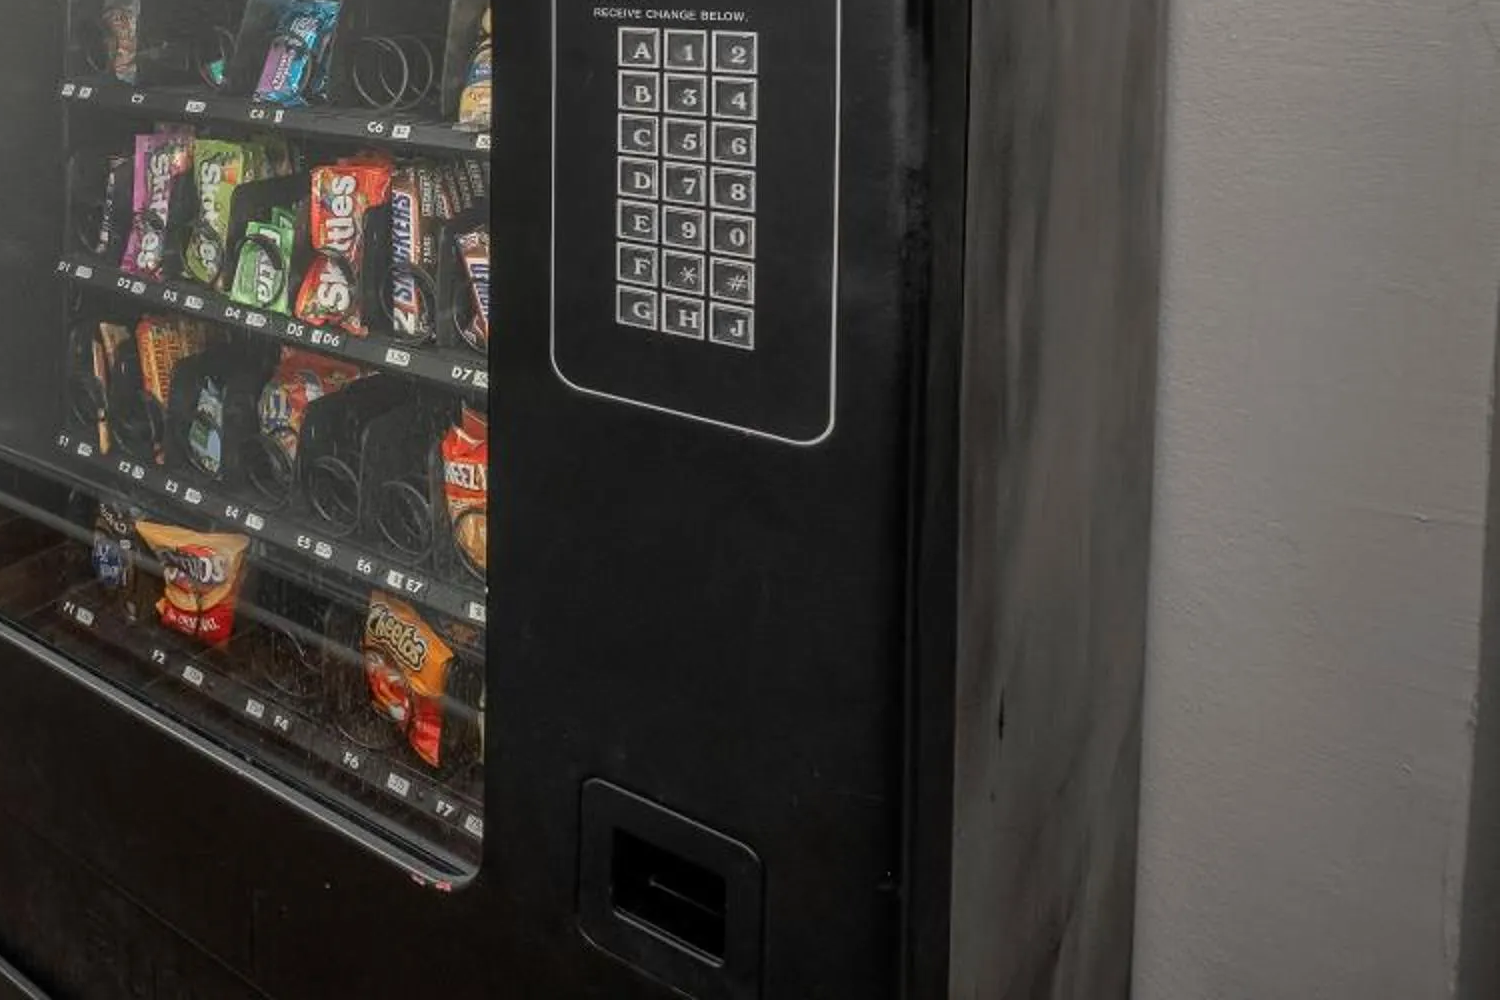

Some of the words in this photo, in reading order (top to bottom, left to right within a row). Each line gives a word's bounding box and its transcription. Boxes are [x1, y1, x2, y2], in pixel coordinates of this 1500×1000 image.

[593, 7, 641, 19] RECEIVE
[645, 9, 697, 21] CHANGE
[632, 42, 652, 60] A
[683, 44, 694, 62] 1
[729, 45, 747, 65] 2
[634, 85, 652, 103] B
[681, 88, 697, 106] 3
[731, 91, 747, 111] 4
[367, 121, 384, 133] C6
[633, 128, 651, 147] C
[681, 133, 697, 151] 5
[731, 137, 747, 156] 6
[633, 171, 653, 190] D
[682, 177, 697, 195] 7
[730, 183, 747, 201] 8
[633, 214, 651, 233] E
[681, 221, 697, 239] 9
[729, 228, 746, 247] 0
[633, 257, 651, 275] F
[117, 277, 132, 289] D2
[726, 275, 749, 292] #
[163, 289, 178, 303] D3
[224, 306, 241, 320] D4
[632, 301, 653, 321] G
[679, 309, 701, 329] H
[286, 322, 305, 337] D5
[729, 319, 745, 338] J
[322, 332, 340, 347] D6
[451, 365, 475, 384] D7
[225, 505, 239, 519] E4
[297, 535, 311, 549] E5
[356, 558, 372, 574] E6
[405, 578, 424, 593] E7
[367, 605, 424, 666] Cheetos
[151, 649, 165, 665] F2
[273, 715, 289, 731] F4
[343, 751, 360, 769] F6
[435, 799, 455, 817] F7
